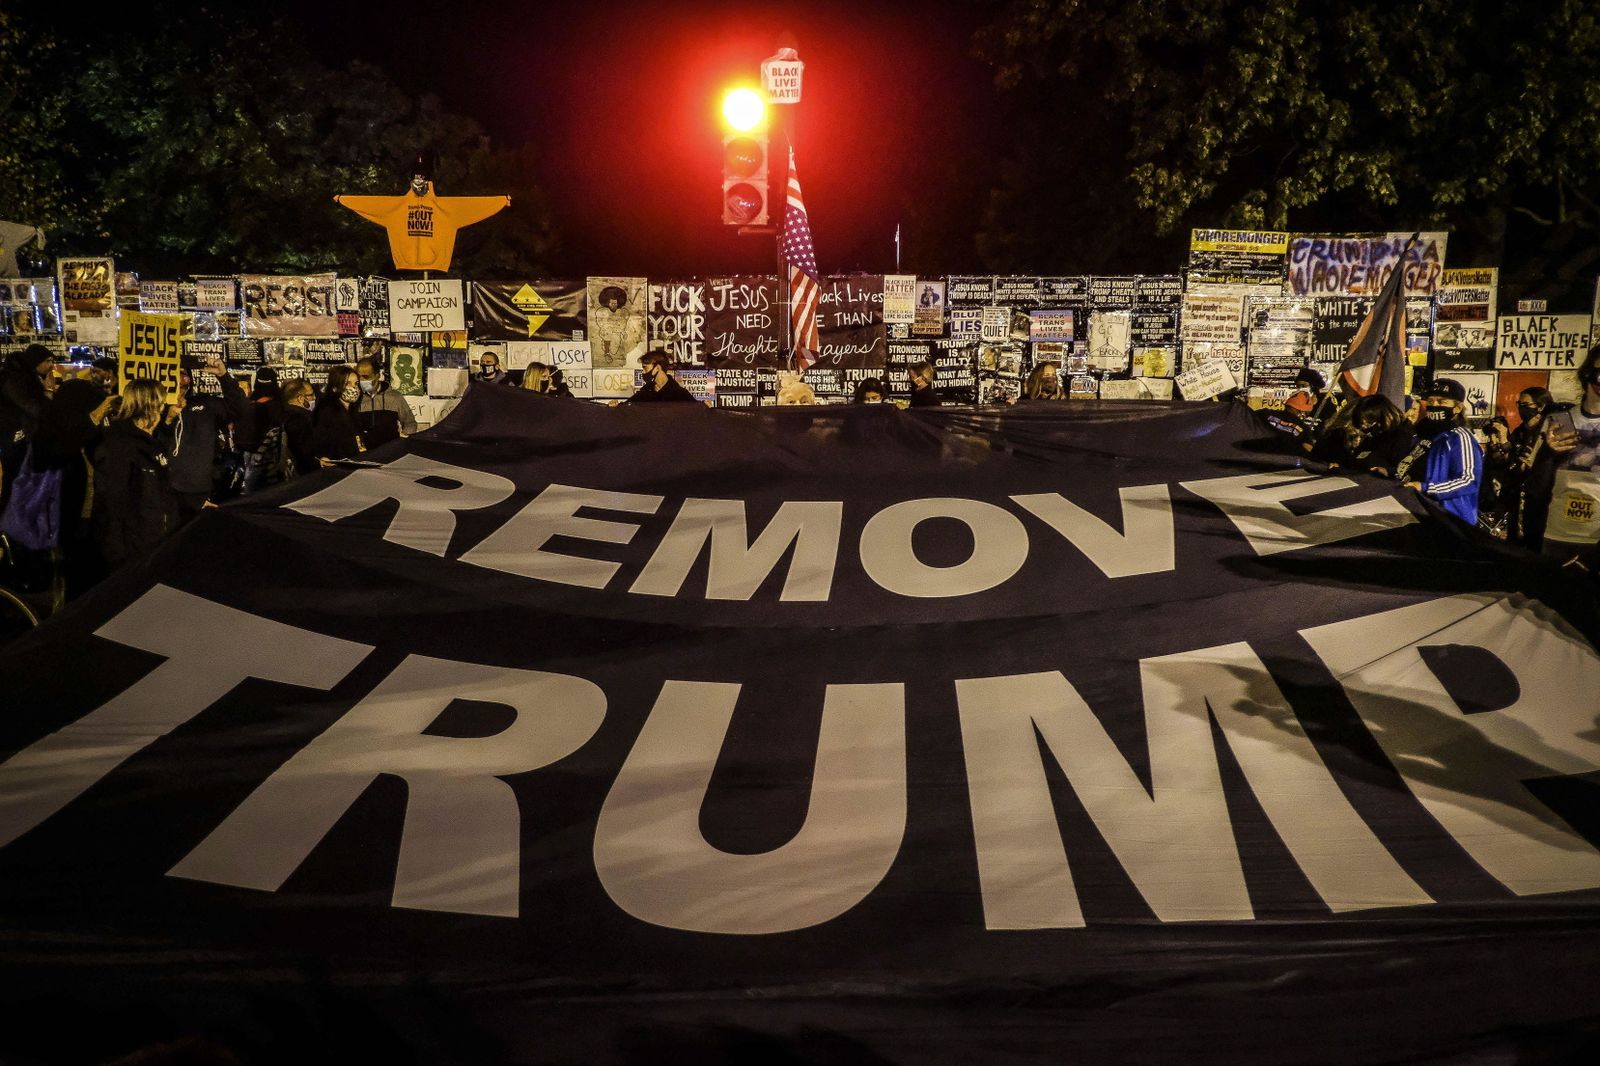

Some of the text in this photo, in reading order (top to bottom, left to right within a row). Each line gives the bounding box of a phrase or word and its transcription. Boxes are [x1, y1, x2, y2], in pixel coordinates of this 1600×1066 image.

[408, 220, 434, 231] NOW!
[1194, 230, 1286, 244] WHOREMONGER
[409, 282, 441, 295] JOIN
[1111, 280, 1134, 288] KNOWS
[143, 286, 175, 295] BLACK
[847, 283, 884, 303] Lives
[1091, 288, 1136, 296] TRUMP CHEATS
[244, 284, 334, 320] RESIST
[397, 297, 458, 310] CAMPAIGN
[648, 284, 706, 312] FUCK
[710, 284, 770, 312] JESUS
[1093, 295, 1107, 303] AND
[142, 301, 177, 309] MATTER
[367, 301, 377, 309] IS
[1317, 301, 1359, 316] WHITE
[412, 313, 444, 329] ZERO
[736, 314, 772, 329] NEED
[834, 311, 873, 326] THAN
[1329, 319, 1342, 329] the
[648, 314, 705, 341] YOUR
[951, 320, 983, 332] LIES
[1502, 316, 1560, 335] BLACK
[125, 323, 177, 358] JESUS
[935, 340, 970, 349] TRUMP
[1500, 333, 1590, 350] TRANS LIVES
[187, 342, 223, 353] REMOVE
[308, 342, 343, 352] STRONGMEN
[889, 344, 930, 355] STRONGMEN
[1313, 344, 1348, 361] WHITE
[306, 351, 345, 361] ABUSE POWER
[551, 347, 590, 366] Loser
[891, 353, 927, 363] ARE WEAK
[948, 349, 958, 358] IS
[935, 357, 972, 368] GUILTY
[1499, 351, 1576, 370] MATTER
[716, 369, 741, 378] STATE
[804, 374, 836, 383] DIGS HIS
[845, 368, 884, 381] TRUMP
[936, 370, 970, 380] WHAT ARE
[764, 382, 772, 391] IS
[816, 382, 841, 391] GRAVE
[844, 381, 855, 394] IS
[949, 377, 976, 388] HIDING?
[719, 395, 753, 407] TRUMP
[1261, 399, 1288, 408] FUCK
[1570, 501, 1592, 511] OUT
[1567, 508, 1594, 519] NOW
[280, 454, 1420, 603] REMOVE
[0, 583, 1600, 936] TRUMP
